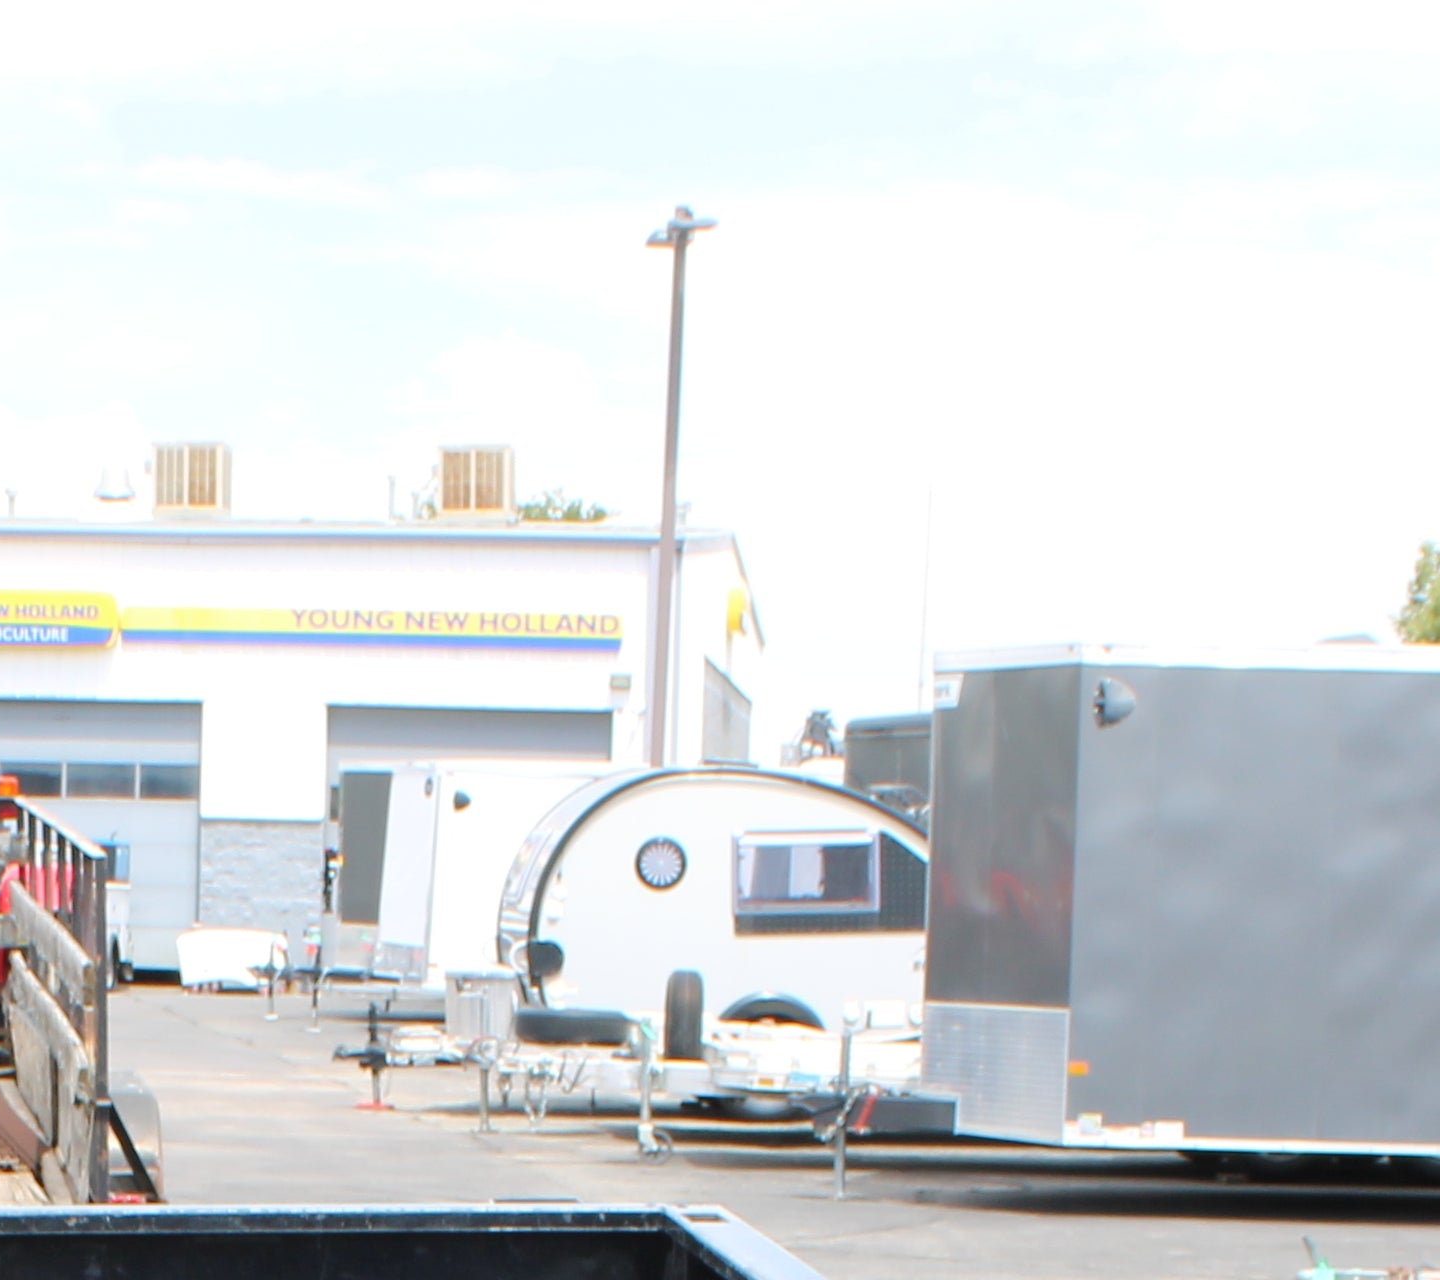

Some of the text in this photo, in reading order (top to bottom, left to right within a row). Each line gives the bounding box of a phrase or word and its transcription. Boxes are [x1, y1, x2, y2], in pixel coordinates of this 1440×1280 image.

[15, 604, 99, 620] HOLLAND
[291, 608, 619, 635] YOUNG NEW HOLLAND
